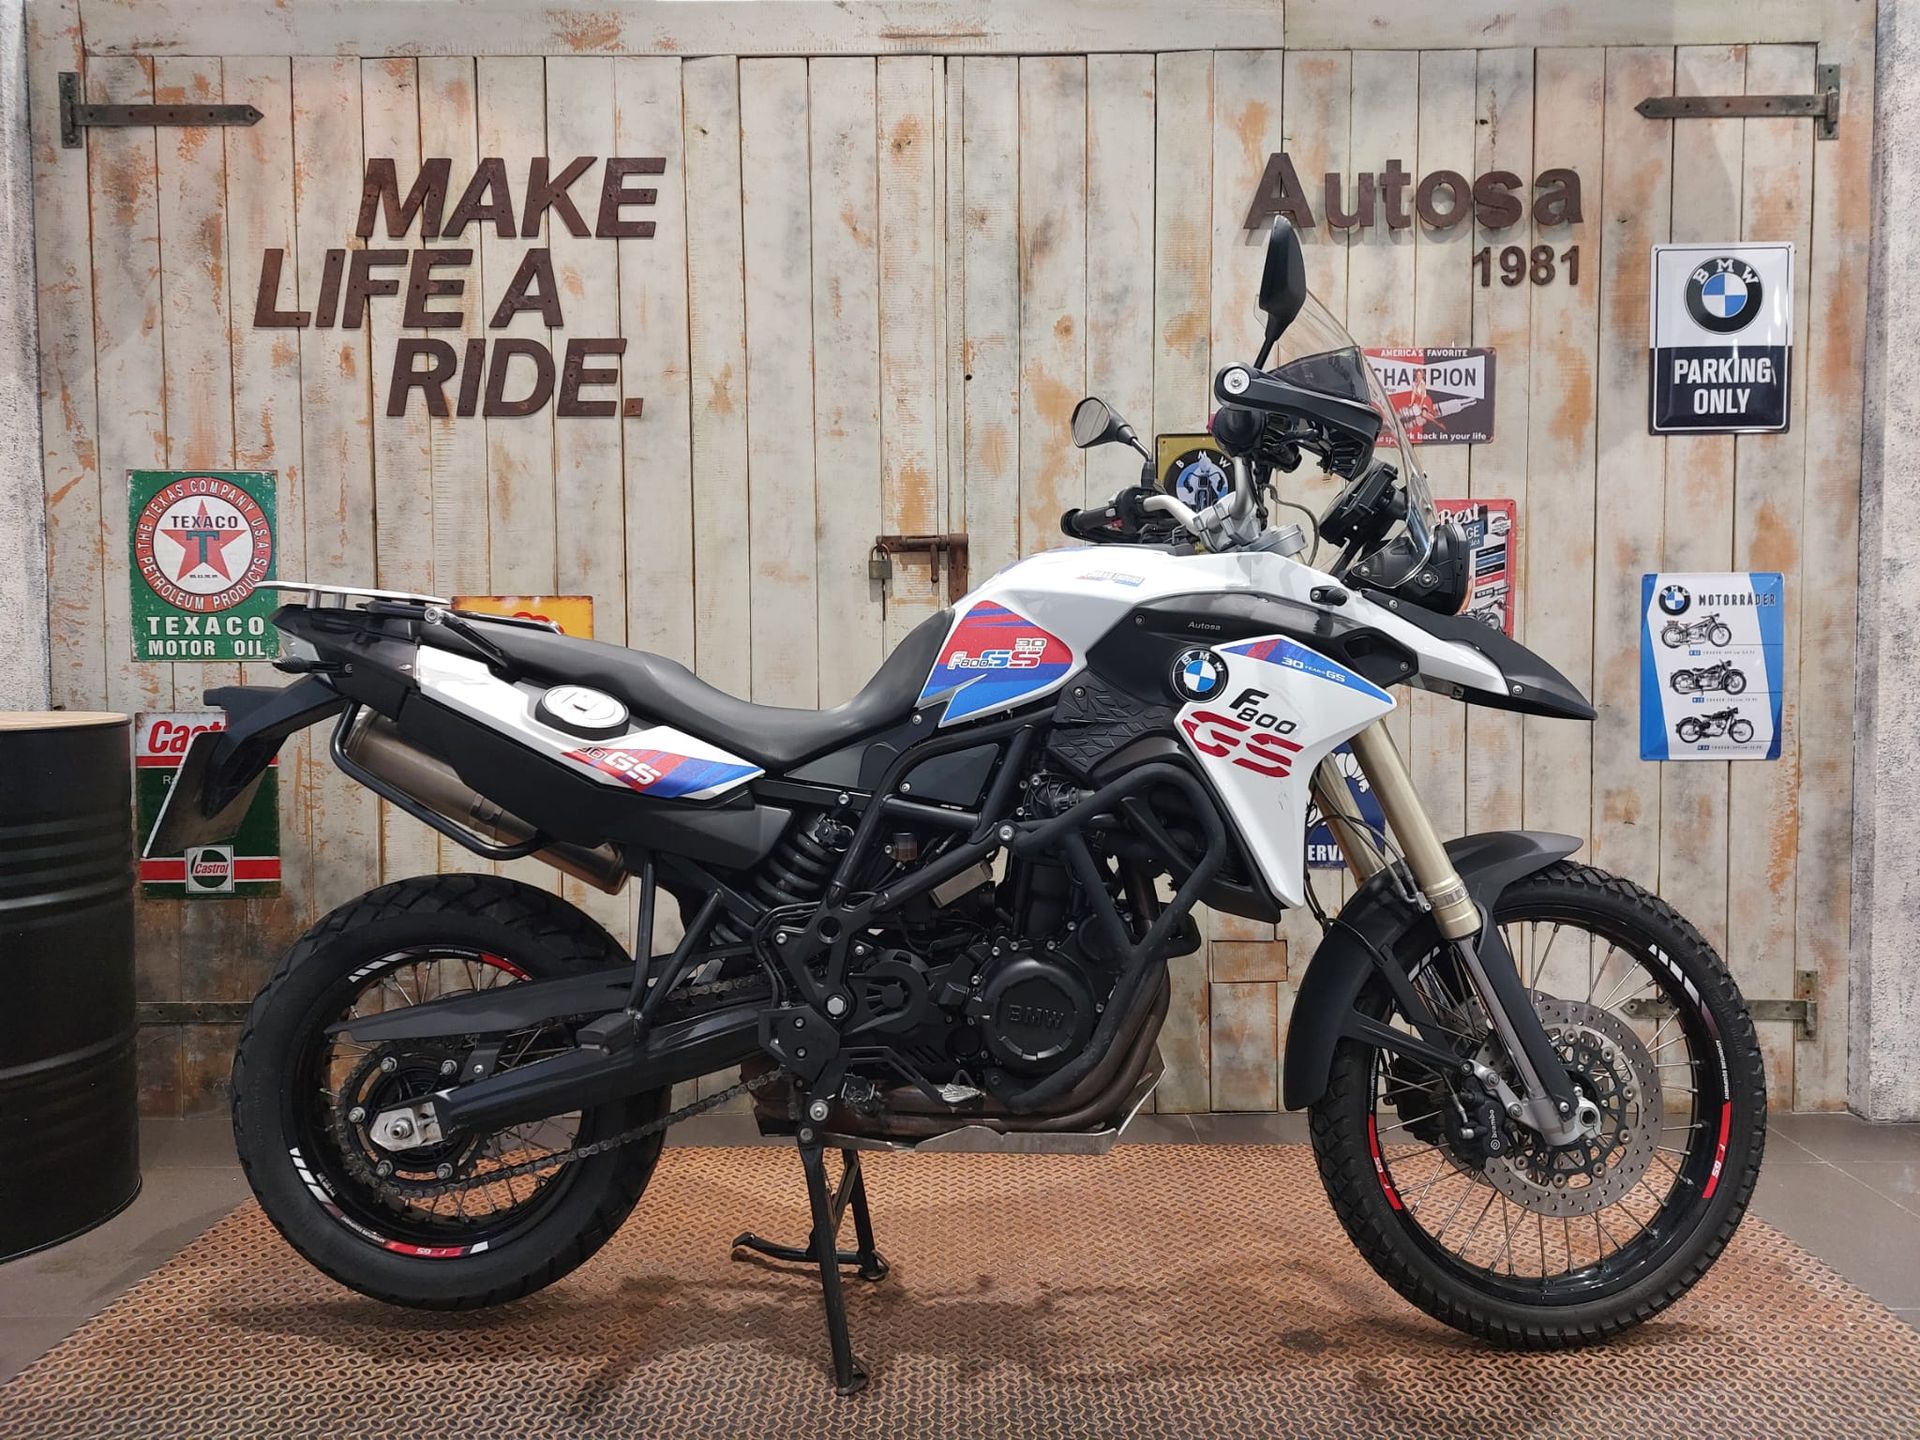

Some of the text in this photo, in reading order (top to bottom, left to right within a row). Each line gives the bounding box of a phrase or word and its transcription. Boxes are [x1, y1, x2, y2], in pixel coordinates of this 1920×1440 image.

[356, 156, 667, 238] MAKE
[1243, 152, 1584, 230] Autosa
[1472, 245, 1580, 287] 1981
[1692, 259, 1759, 285] BMW
[253, 248, 564, 328] LIFE A
[1381, 349, 1468, 357] AMERICA'S FAVORITE
[386, 338, 644, 417] RIDE.
[1674, 358, 1771, 384] PARKING
[1694, 388, 1750, 414] ONLY
[1417, 431, 1437, 440] back
[1440, 431, 1448, 440] in
[1450, 432, 1470, 442] your
[1472, 431, 1487, 440] life
[1176, 451, 1231, 468] BMW
[138, 523, 152, 550] THE
[145, 484, 185, 518] TEXAS
[190, 480, 255, 512] COMPANY
[171, 515, 238, 529] TEXACO
[1439, 503, 1480, 526] Best
[140, 556, 266, 610] PETROLEUM PRODUCTS
[147, 616, 265, 636] TEXACO
[1188, 621, 1221, 631] Autosa
[149, 640, 266, 656] MOTOR OIL
[1181, 652, 1223, 671] BMW
[1281, 656, 1304, 669] 30
[1326, 670, 1346, 682] GS
[1229, 688, 1297, 734] F 800
[1182, 711, 1304, 777] GS
[604, 751, 662, 785] GS
[194, 863, 229, 874] Castrol
